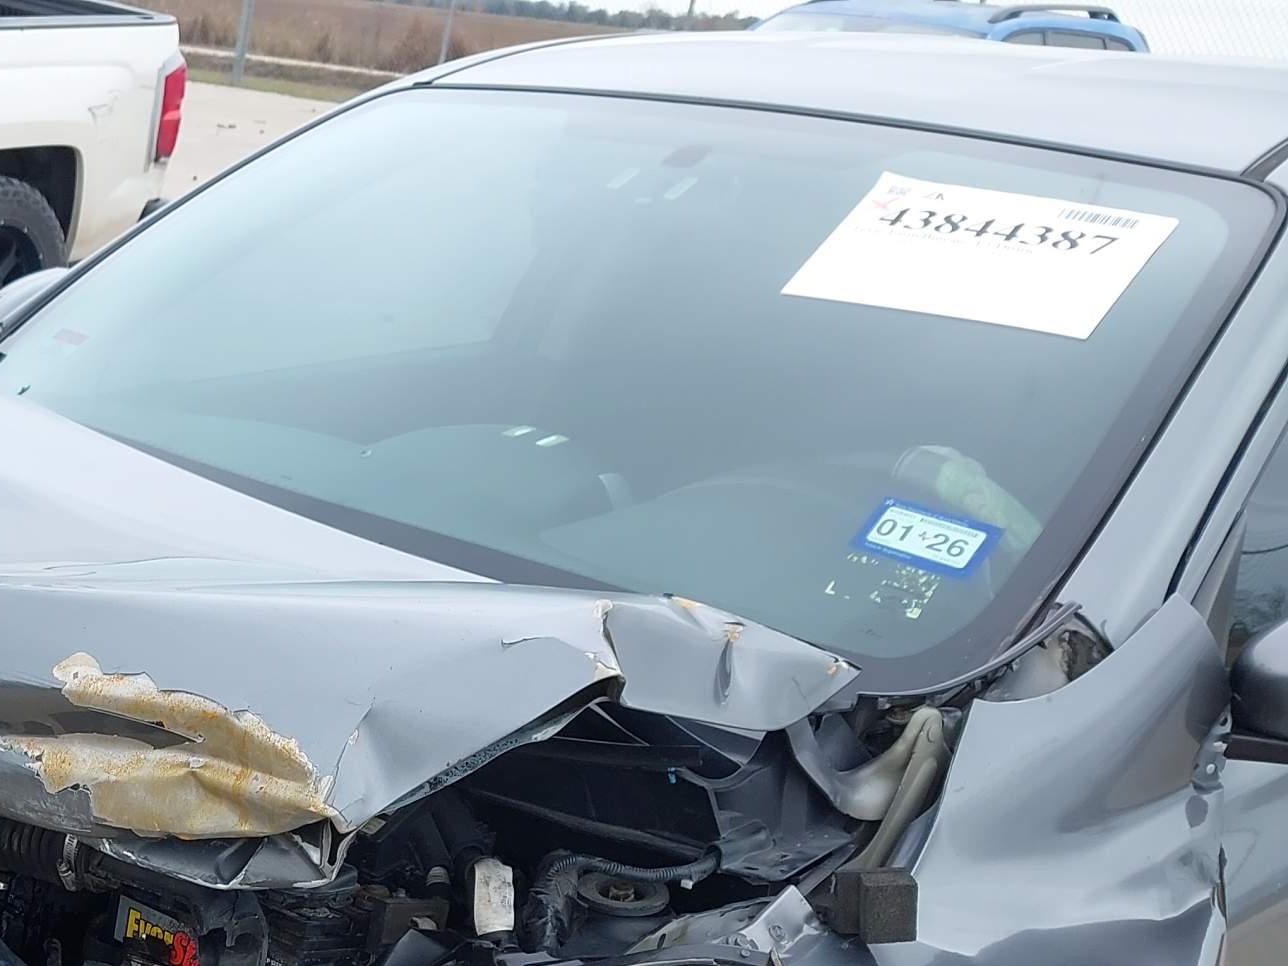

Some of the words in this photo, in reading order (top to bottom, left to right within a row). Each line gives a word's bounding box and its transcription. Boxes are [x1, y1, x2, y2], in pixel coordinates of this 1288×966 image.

[879, 207, 1120, 256] 43844387
[875, 518, 915, 542] 01
[924, 532, 971, 558] 26
